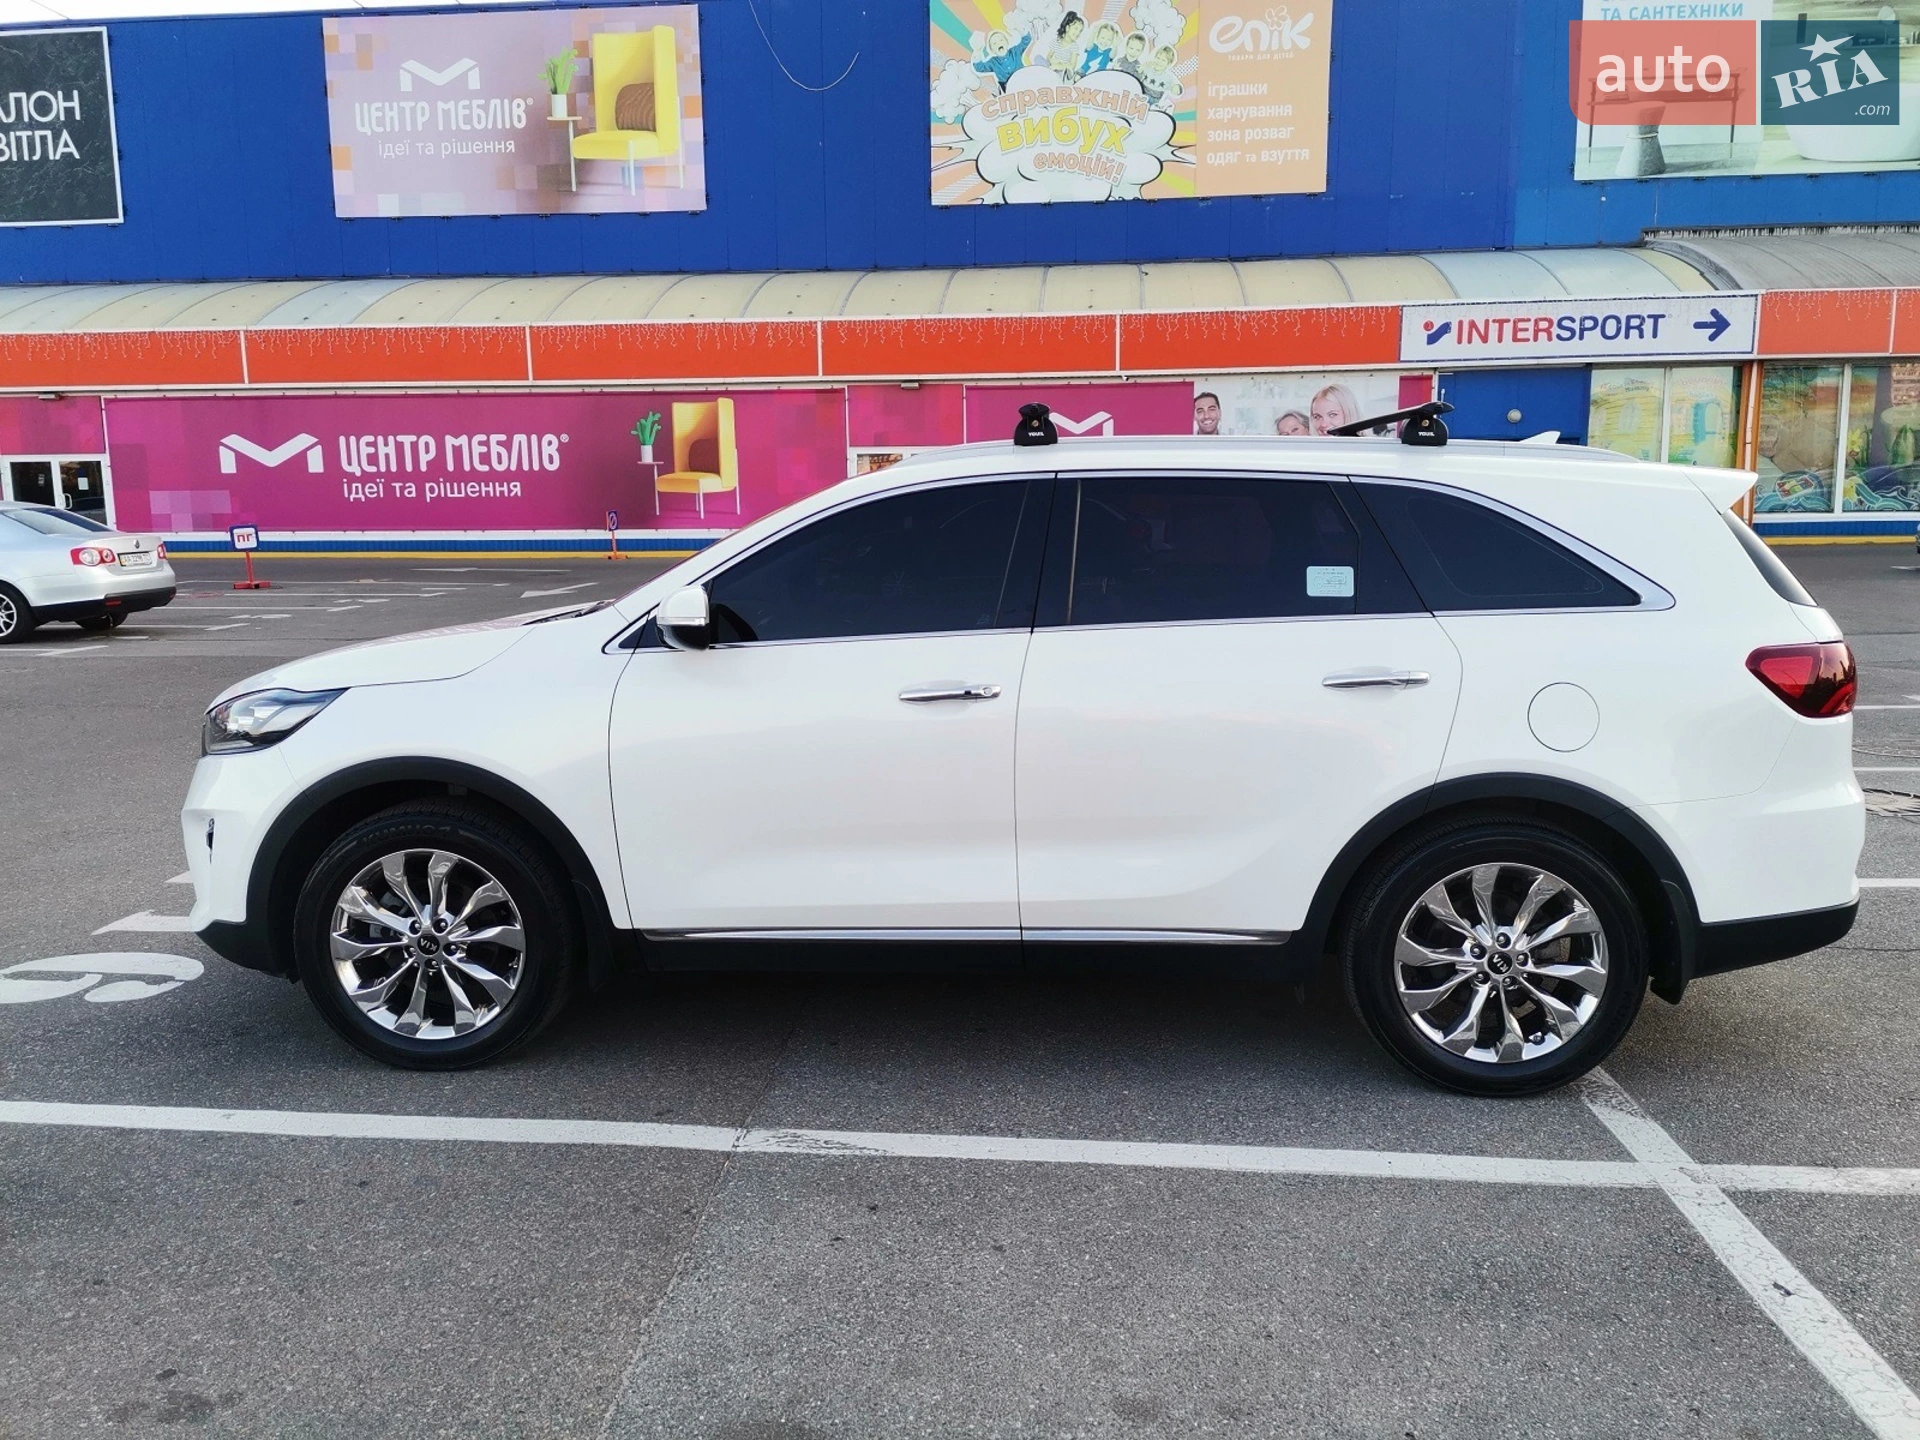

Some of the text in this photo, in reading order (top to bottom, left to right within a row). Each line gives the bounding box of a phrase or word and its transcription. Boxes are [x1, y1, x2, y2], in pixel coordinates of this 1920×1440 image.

[1600, 3, 1744, 21] ТА САНТЕХНІКИ
[981, 86, 1149, 121] справжній
[1207, 82, 1268, 101] іграшки
[0, 90, 81, 122] ЛОН
[354, 101, 431, 136] ЦЕНТР
[1207, 104, 1293, 123] харчування
[996, 106, 1131, 154] вибух
[1207, 126, 1295, 144] зона розваг
[378, 139, 516, 159] ідеї та рішення
[1206, 149, 1310, 166] одяг та взуття
[1456, 313, 1667, 345] INTERSPORT
[338, 434, 437, 477] ЦЕНТР
[342, 478, 522, 503] ідеї та рішення
